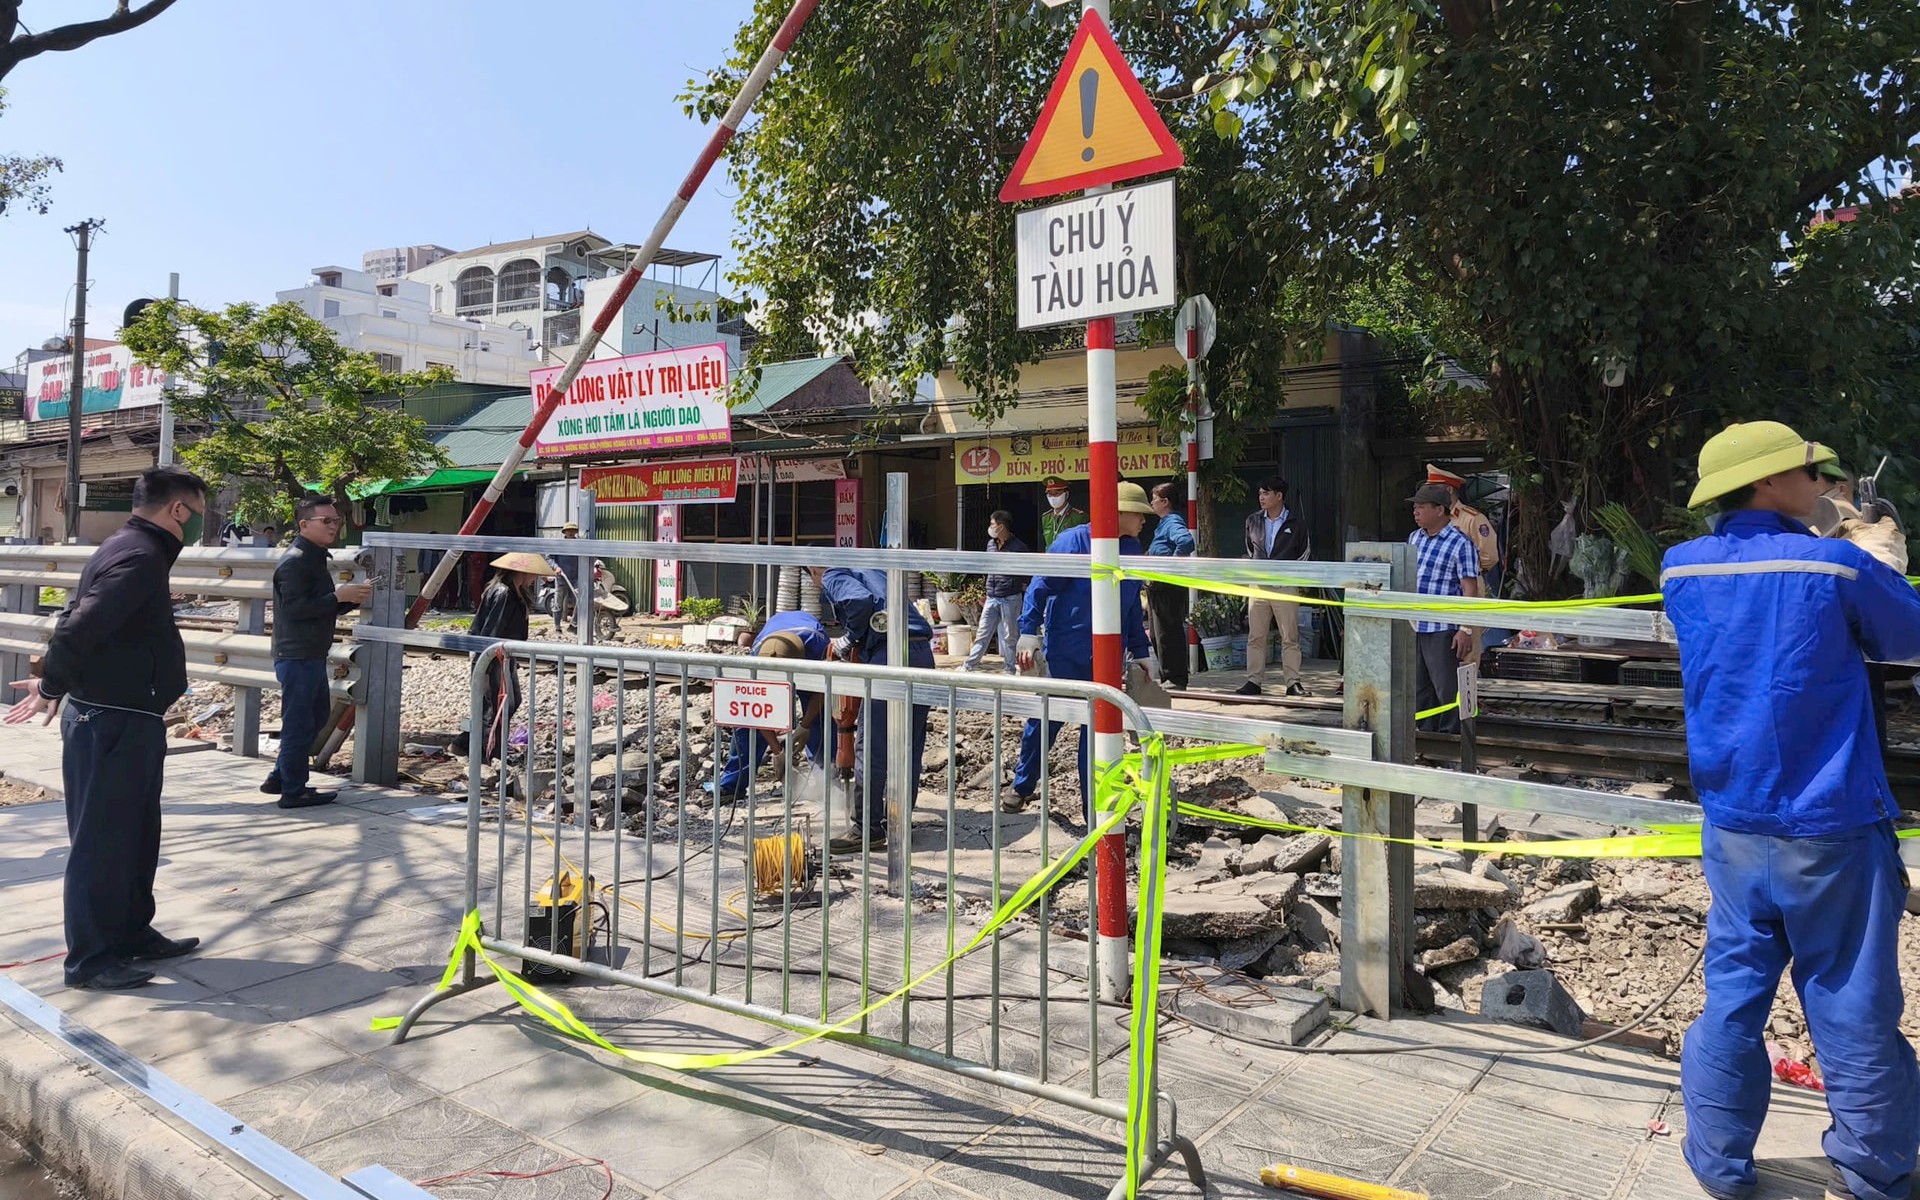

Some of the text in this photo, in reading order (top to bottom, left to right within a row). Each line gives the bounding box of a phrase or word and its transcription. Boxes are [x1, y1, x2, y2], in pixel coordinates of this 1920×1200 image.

[1049, 190, 1136, 257] CHÚ Ý
[1031, 245, 1158, 314] TÀU HỎA
[570, 375, 605, 405] LƯNG
[607, 367, 635, 405] VẬT
[638, 363, 654, 397] LÝ
[658, 365, 684, 398] TRỊ
[687, 355, 722, 396] LIỆU
[557, 413, 584, 437] XÔNG
[585, 413, 601, 433] HƠI
[628, 408, 641, 429] LÁ
[643, 404, 675, 428] NGƯỜI
[678, 405, 701, 425] DAO
[968, 449, 991, 466] 12
[1006, 457, 1032, 476] BÚN
[1040, 454, 1065, 475] PHỞ
[1117, 454, 1149, 471] GAN
[840, 536, 853, 547] CAO
[735, 685, 767, 696] POLICE
[729, 700, 773, 719] STOP
